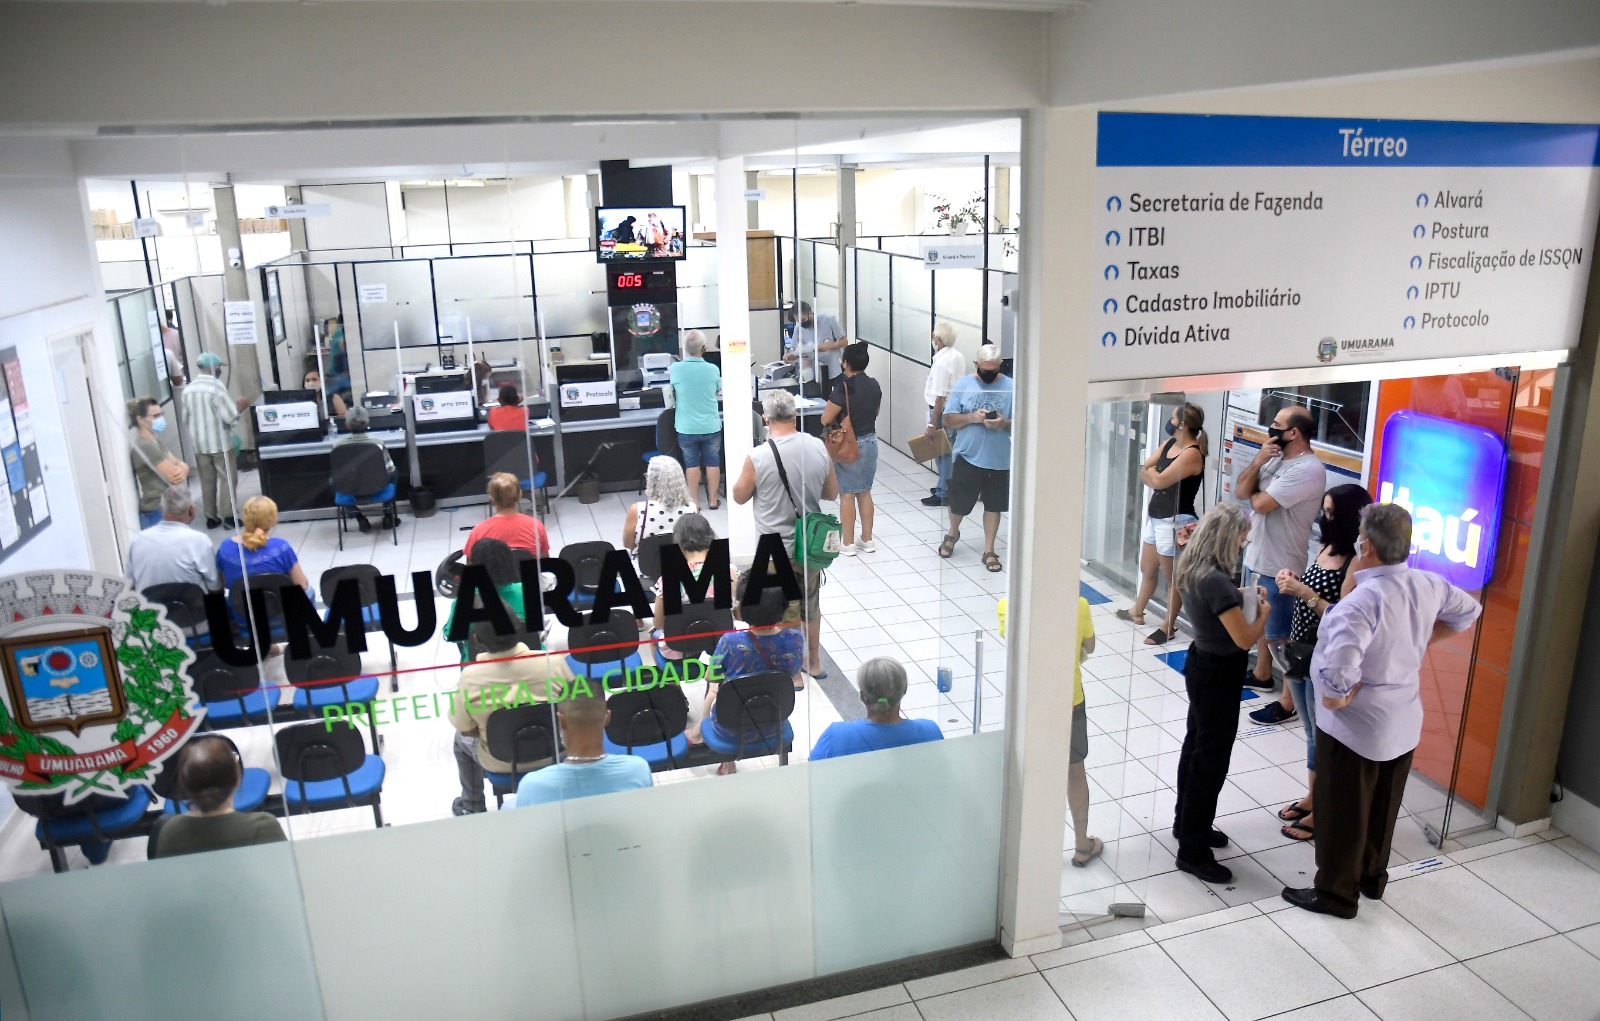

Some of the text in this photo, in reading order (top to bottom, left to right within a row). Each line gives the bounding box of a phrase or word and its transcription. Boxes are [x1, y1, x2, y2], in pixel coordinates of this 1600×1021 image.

[1338, 127, 1408, 157] Térreo
[1129, 191, 1323, 217] Secretaria de Fazenda
[1433, 189, 1484, 209] Alvará
[1128, 227, 1165, 247] ITBI
[1431, 221, 1489, 239] Postura
[1428, 247, 1583, 273] Fiscalização de ISSQN
[617, 274, 642, 288] 005
[1127, 261, 1180, 281] Taxas
[1424, 281, 1461, 300] IPTU
[1125, 288, 1301, 314] Cadastro Imobiliário
[1421, 309, 1489, 329] Protocolo
[1124, 324, 1230, 347] Dívida Ativa
[1341, 337, 1394, 350] UMUARAMA
[585, 390, 614, 398] Protocolo
[203, 533, 802, 668] UMUARAMA
[322, 654, 726, 733] PREFEITURA DA CIDADE
[40, 748, 128, 772] UMUARAMA
[147, 727, 179, 754] 1960
